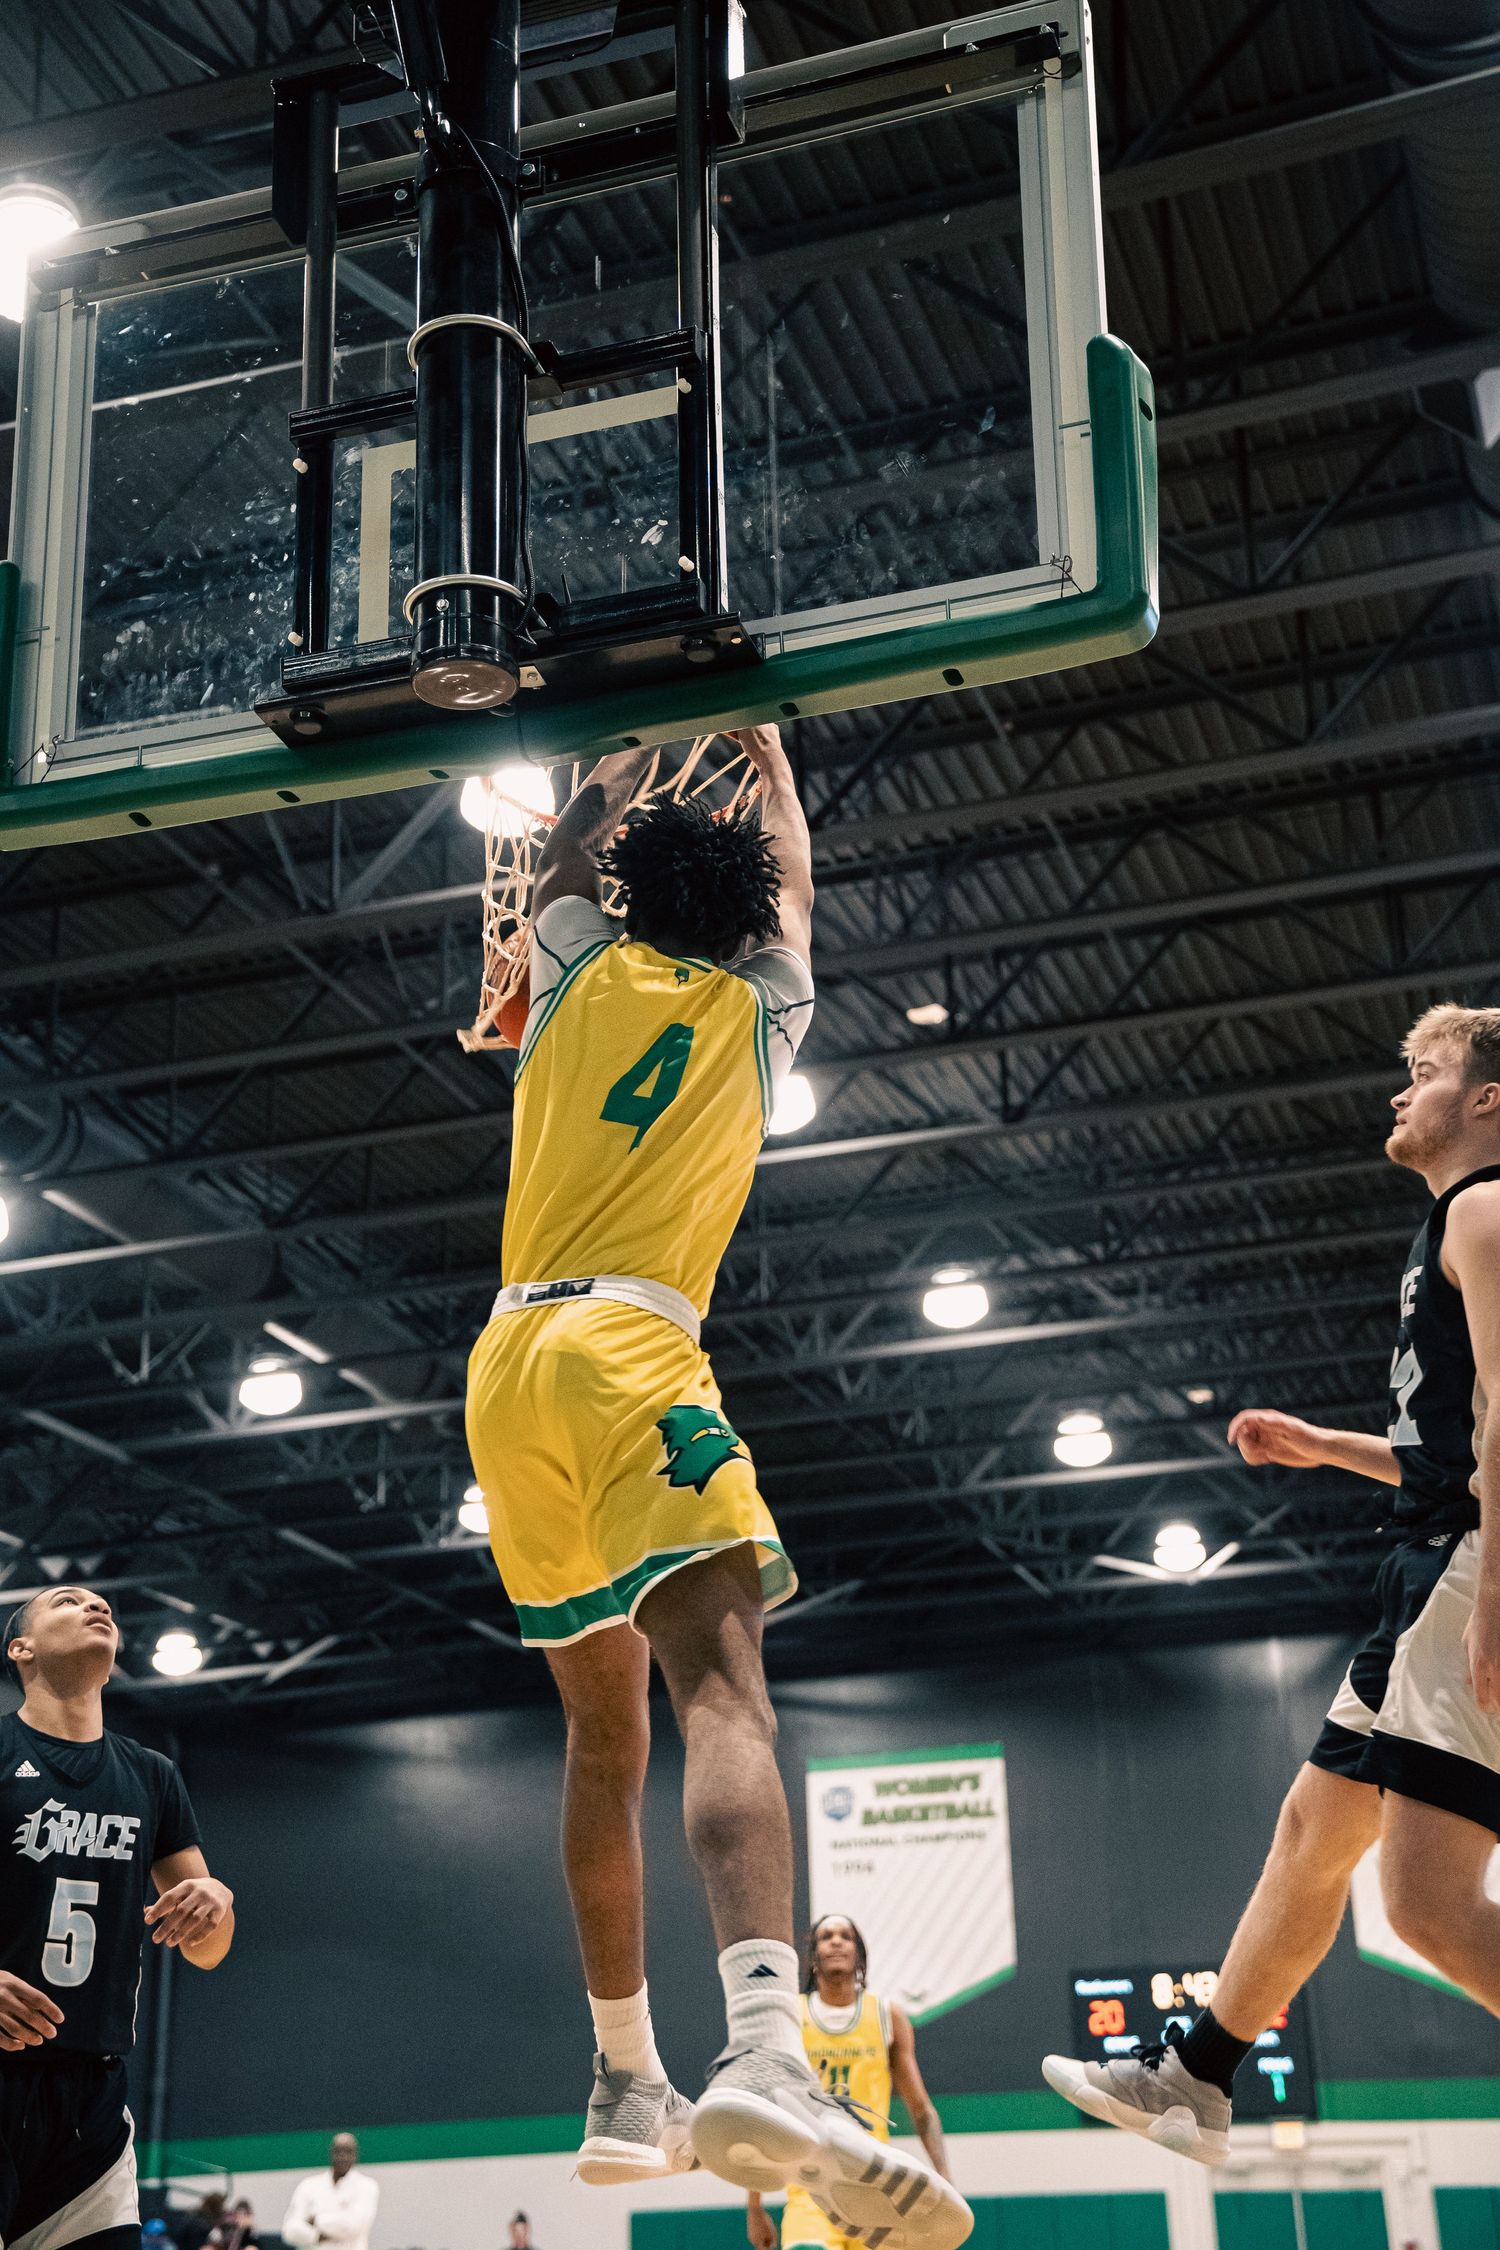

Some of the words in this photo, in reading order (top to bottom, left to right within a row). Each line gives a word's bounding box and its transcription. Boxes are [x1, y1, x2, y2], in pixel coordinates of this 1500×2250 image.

[599, 1023, 694, 1154] 4
[12, 1798, 141, 1862] GRACE
[863, 1800, 995, 1825] BASKETBALL
[41, 1877, 99, 1987] 5
